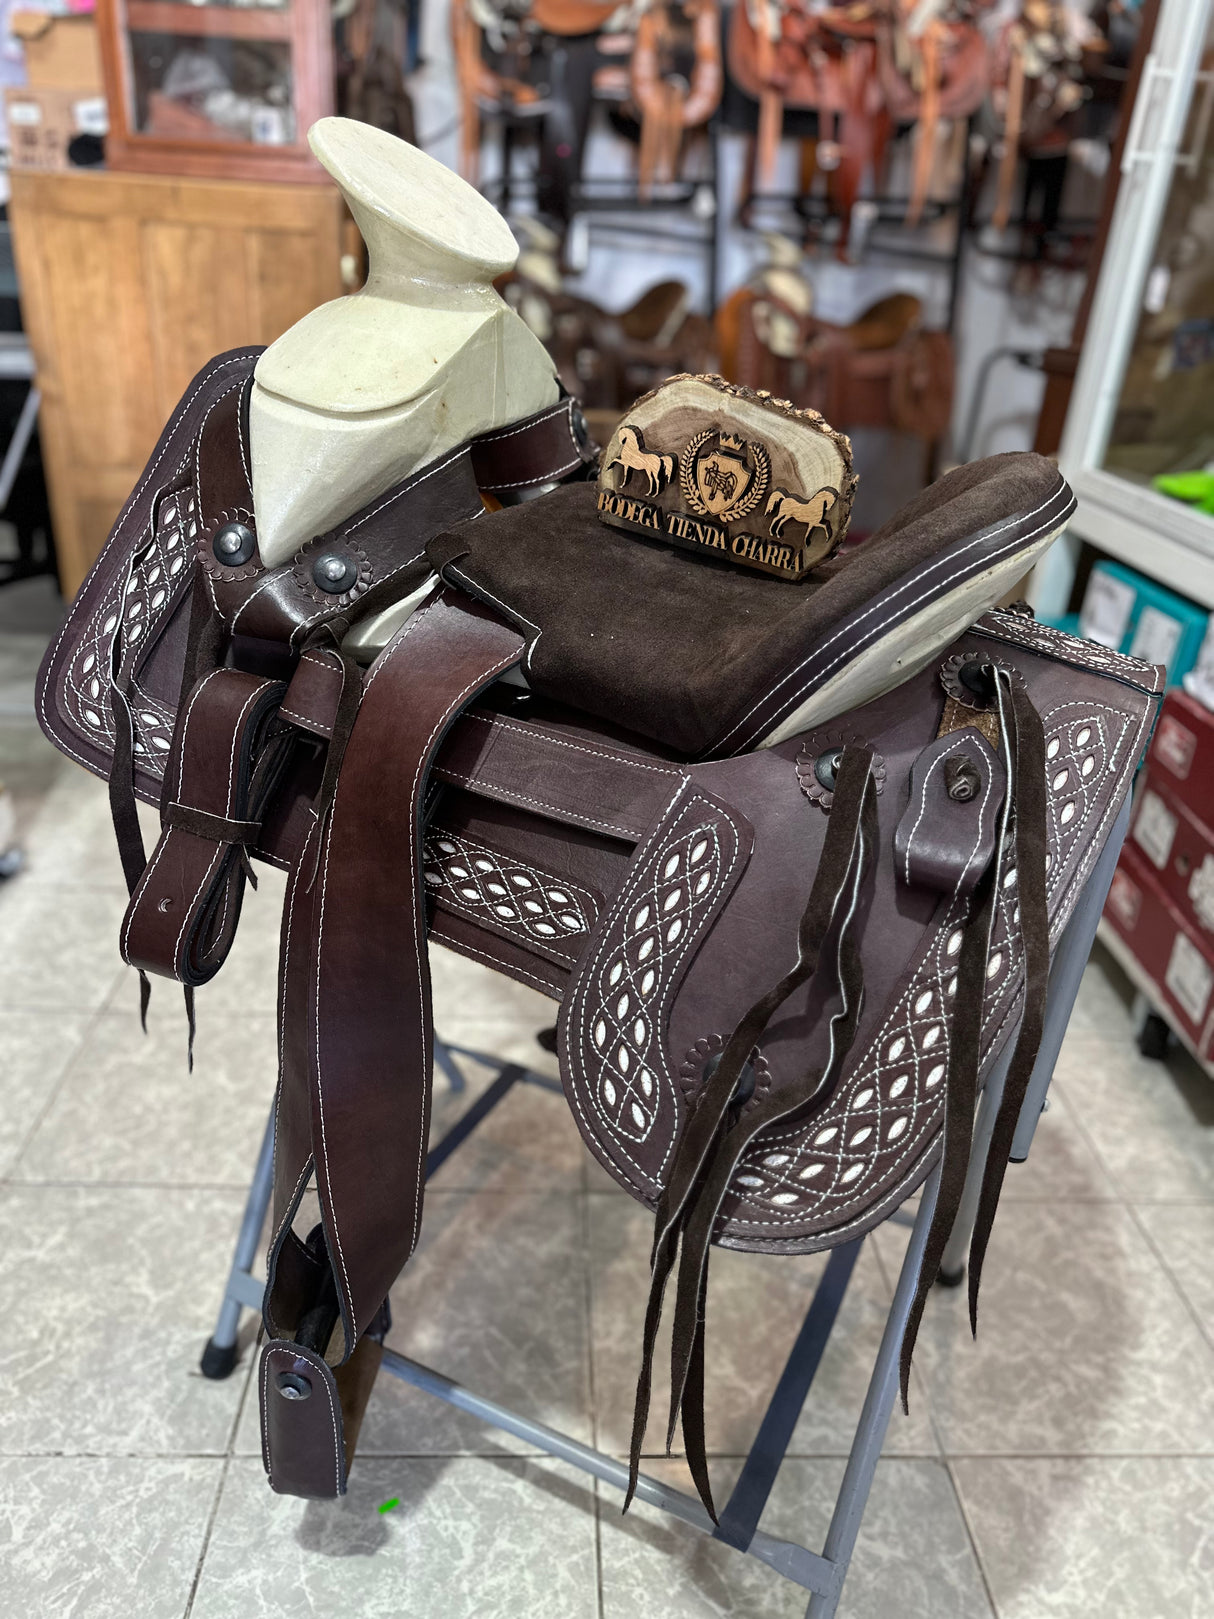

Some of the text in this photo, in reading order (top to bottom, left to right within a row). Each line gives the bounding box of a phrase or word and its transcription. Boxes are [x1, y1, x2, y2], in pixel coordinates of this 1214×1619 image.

[598, 492, 800, 572] BODEGA TIENDA CHARRA
